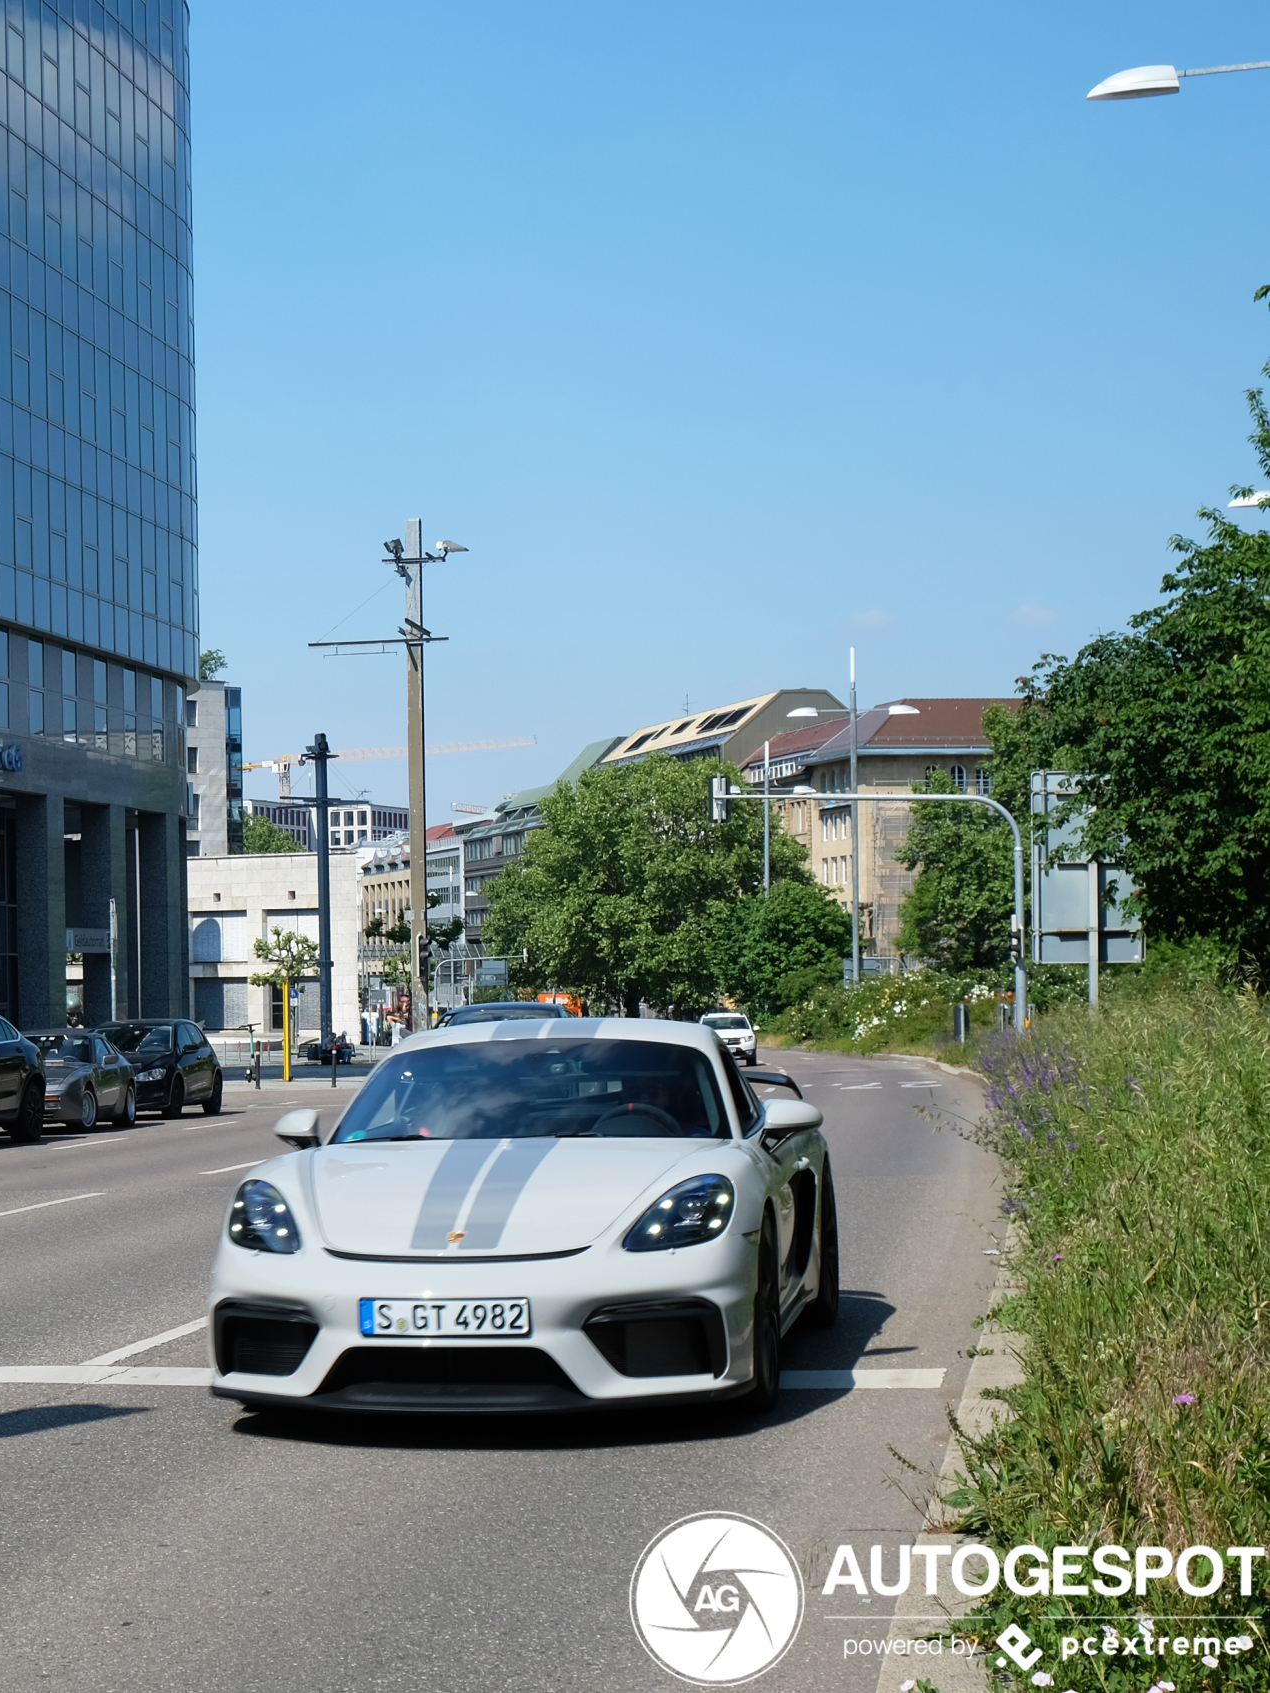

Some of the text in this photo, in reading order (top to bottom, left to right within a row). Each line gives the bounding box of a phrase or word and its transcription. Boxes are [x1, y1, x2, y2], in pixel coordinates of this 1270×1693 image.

[2, 744, 23, 772] eG
[377, 1304, 392, 1329] S
[412, 1304, 445, 1330] GT
[455, 1304, 524, 1330] 4982
